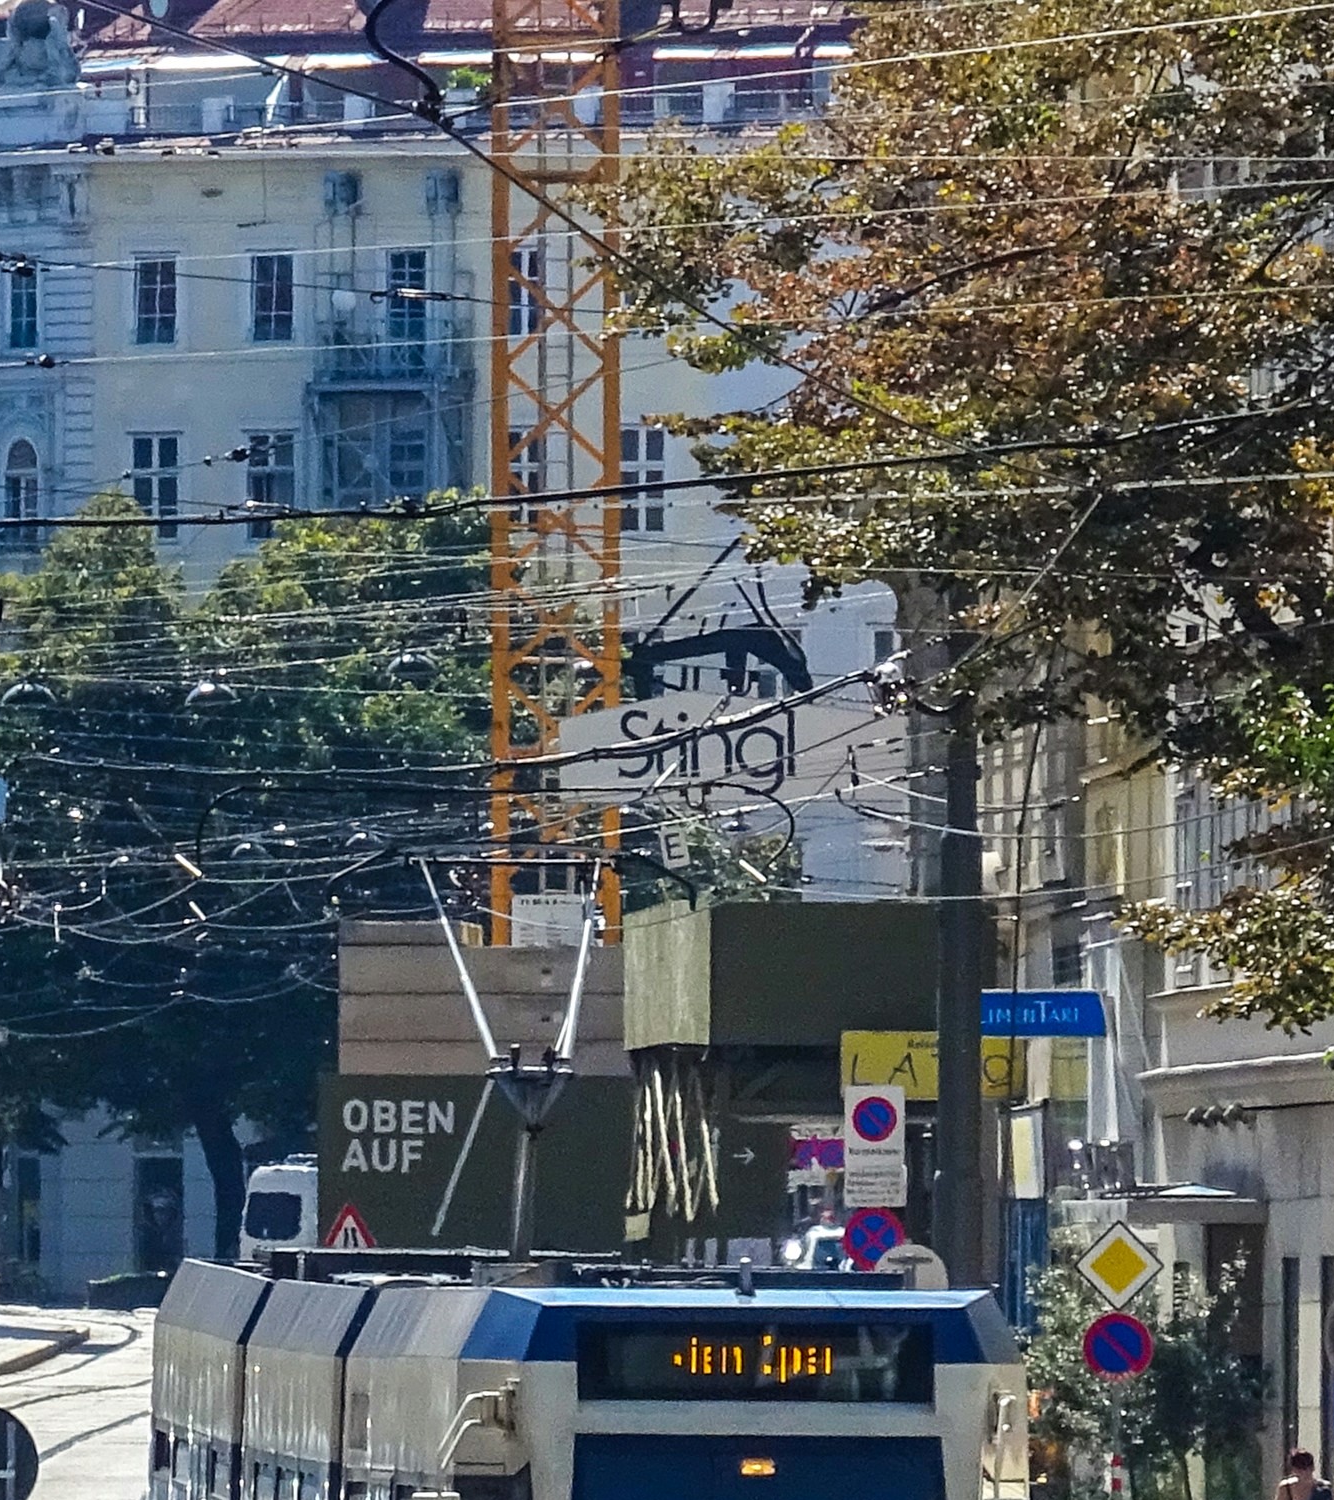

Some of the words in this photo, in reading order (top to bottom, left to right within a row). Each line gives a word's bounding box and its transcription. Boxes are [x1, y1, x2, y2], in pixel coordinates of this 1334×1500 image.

[618, 709, 796, 796] Stingl
[342, 1098, 456, 1134] OBEN
[340, 1138, 425, 1174] AUF
